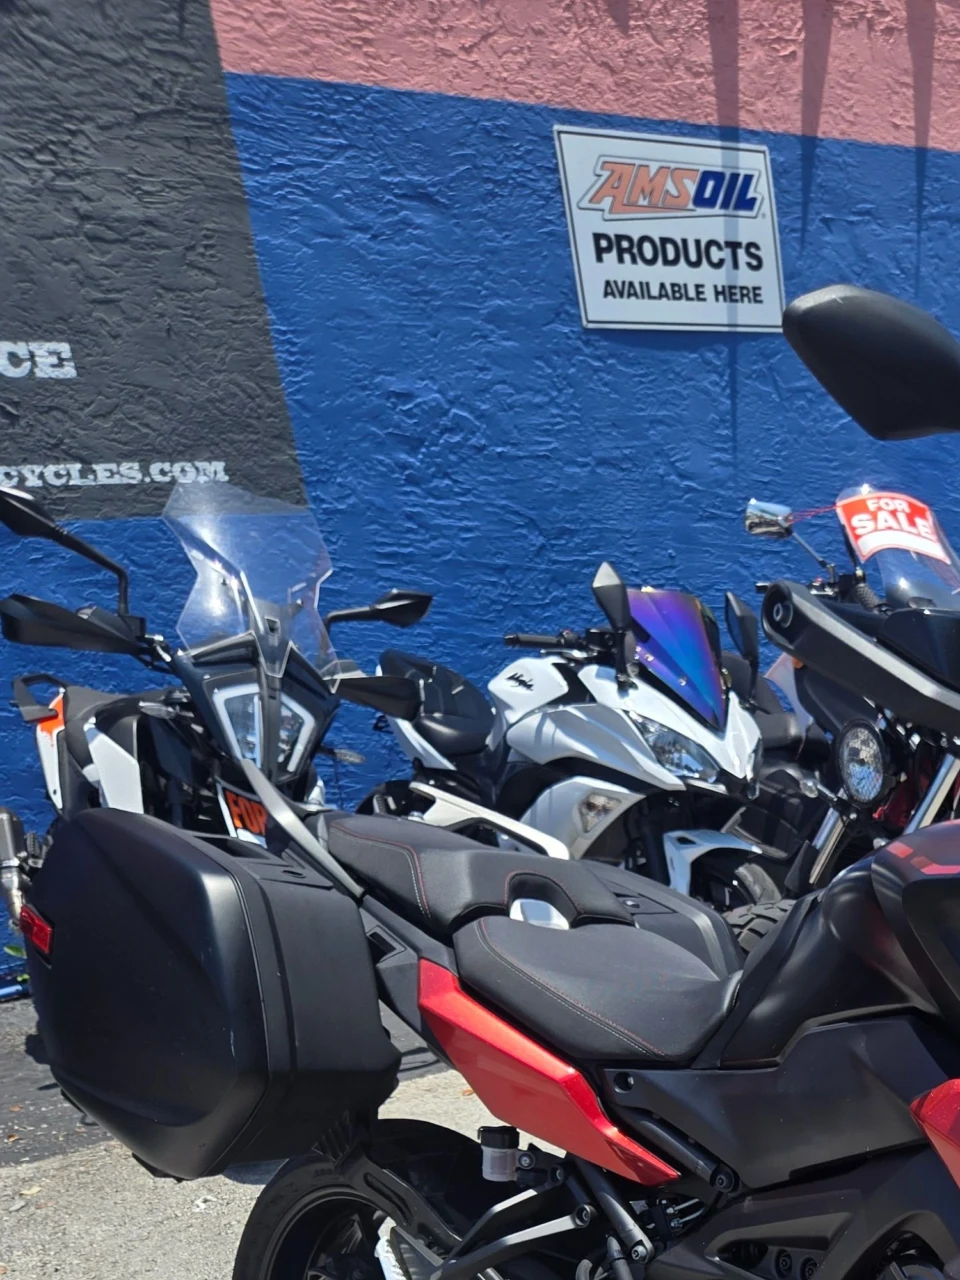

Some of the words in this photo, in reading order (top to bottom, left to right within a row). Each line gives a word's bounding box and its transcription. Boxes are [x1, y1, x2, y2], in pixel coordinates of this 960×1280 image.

[588, 160, 758, 215] AMSOIL
[592, 232, 764, 272] PRODUCTS
[603, 279, 707, 302] AVAILABLE
[713, 285, 764, 304] HERE
[0, 341, 77, 379] CE
[0, 461, 229, 487] CYCLES.COM
[865, 497, 911, 513] FOR
[850, 510, 938, 542] SALE
